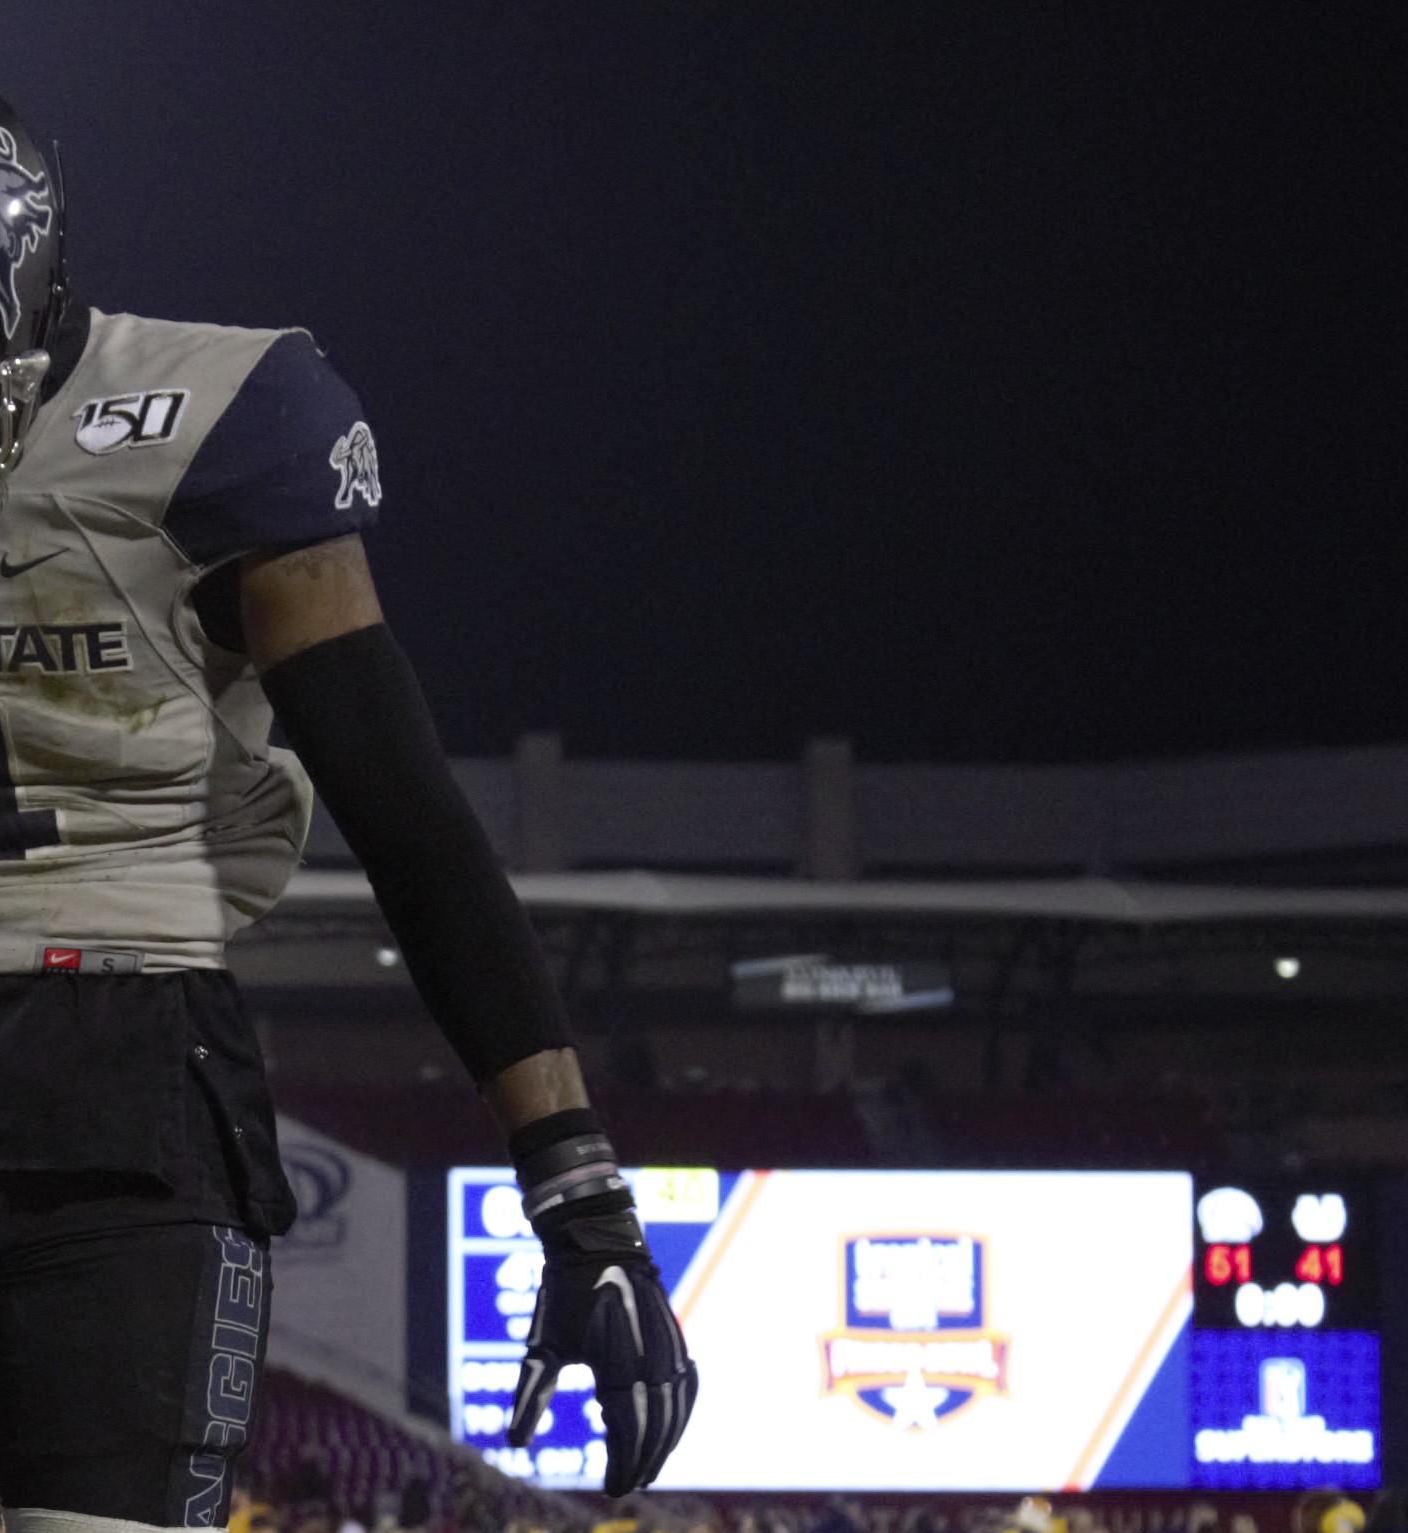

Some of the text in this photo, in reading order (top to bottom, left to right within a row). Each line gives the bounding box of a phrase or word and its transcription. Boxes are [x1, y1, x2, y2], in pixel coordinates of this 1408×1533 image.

[73, 389, 190, 455] 150
[100, 957, 116, 974] S
[1294, 1243, 1344, 1286] 41
